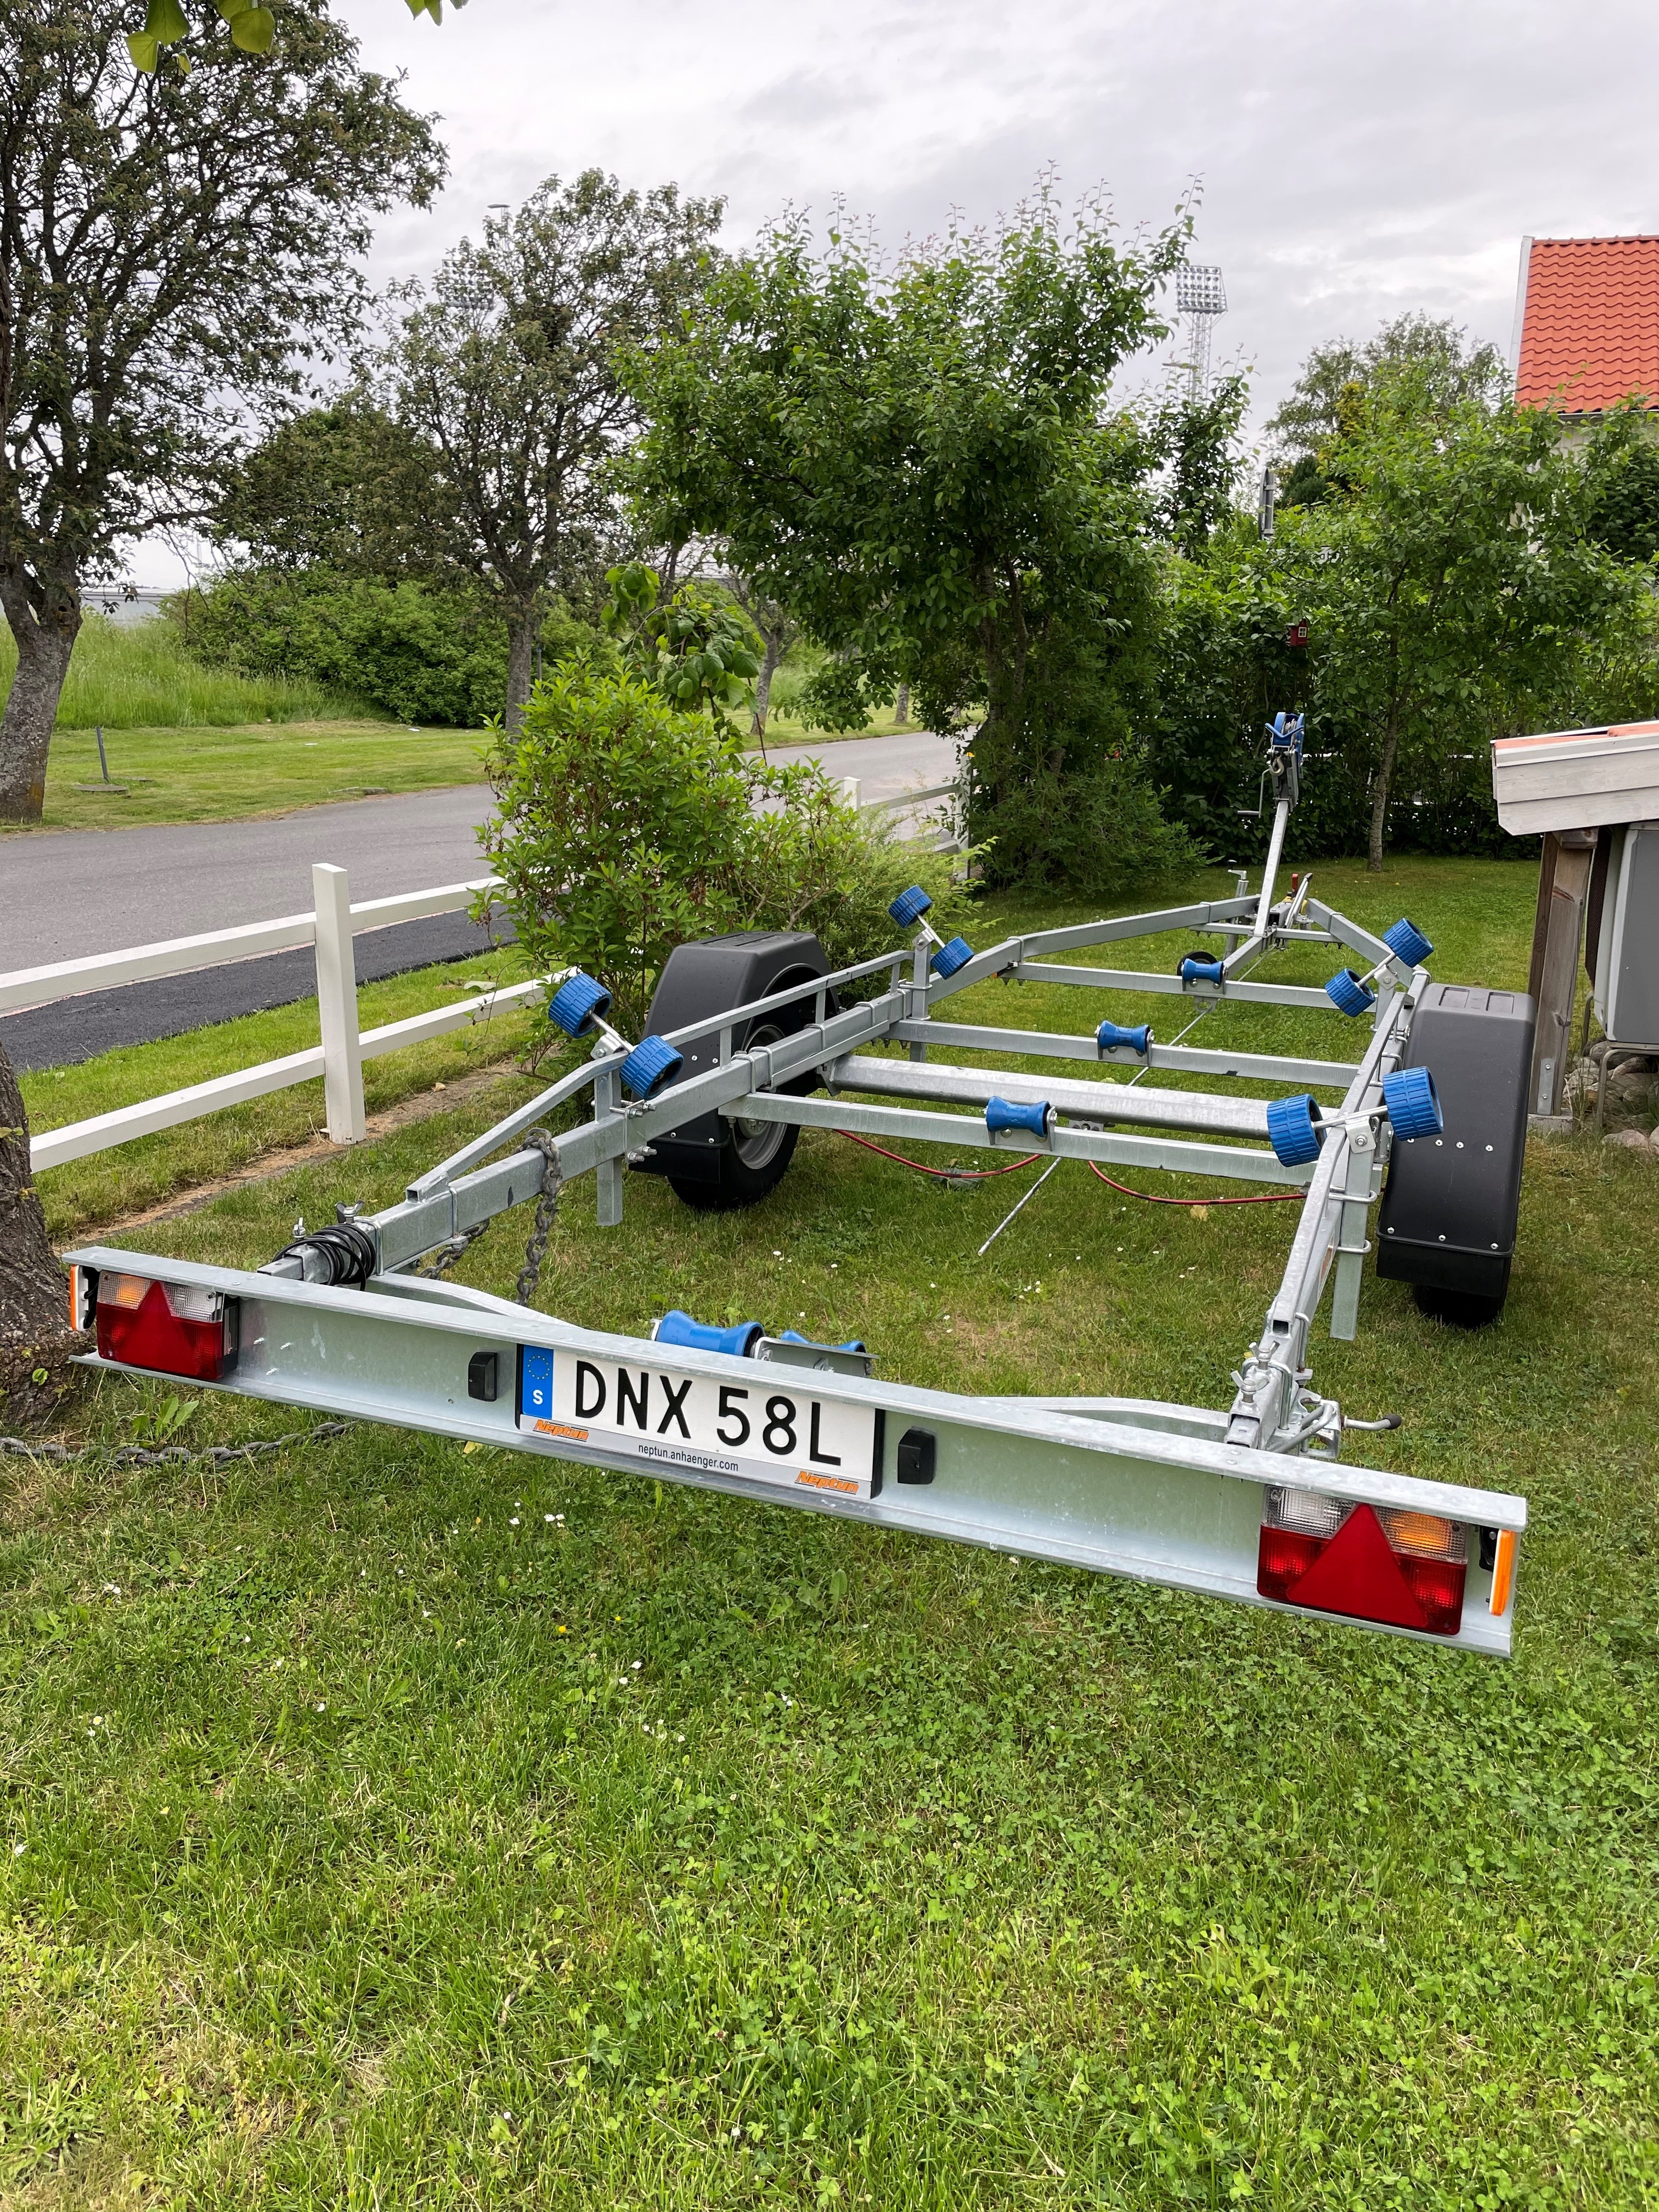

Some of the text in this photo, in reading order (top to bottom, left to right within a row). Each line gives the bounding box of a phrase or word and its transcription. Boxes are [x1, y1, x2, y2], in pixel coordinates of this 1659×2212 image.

[533, 1390, 543, 1405] S
[575, 1360, 840, 1466] DNX 58L
[533, 1419, 589, 1440] Neptun
[638, 1444, 738, 1471] neptun.anhaenger.com
[795, 1471, 859, 1493] Neptun
